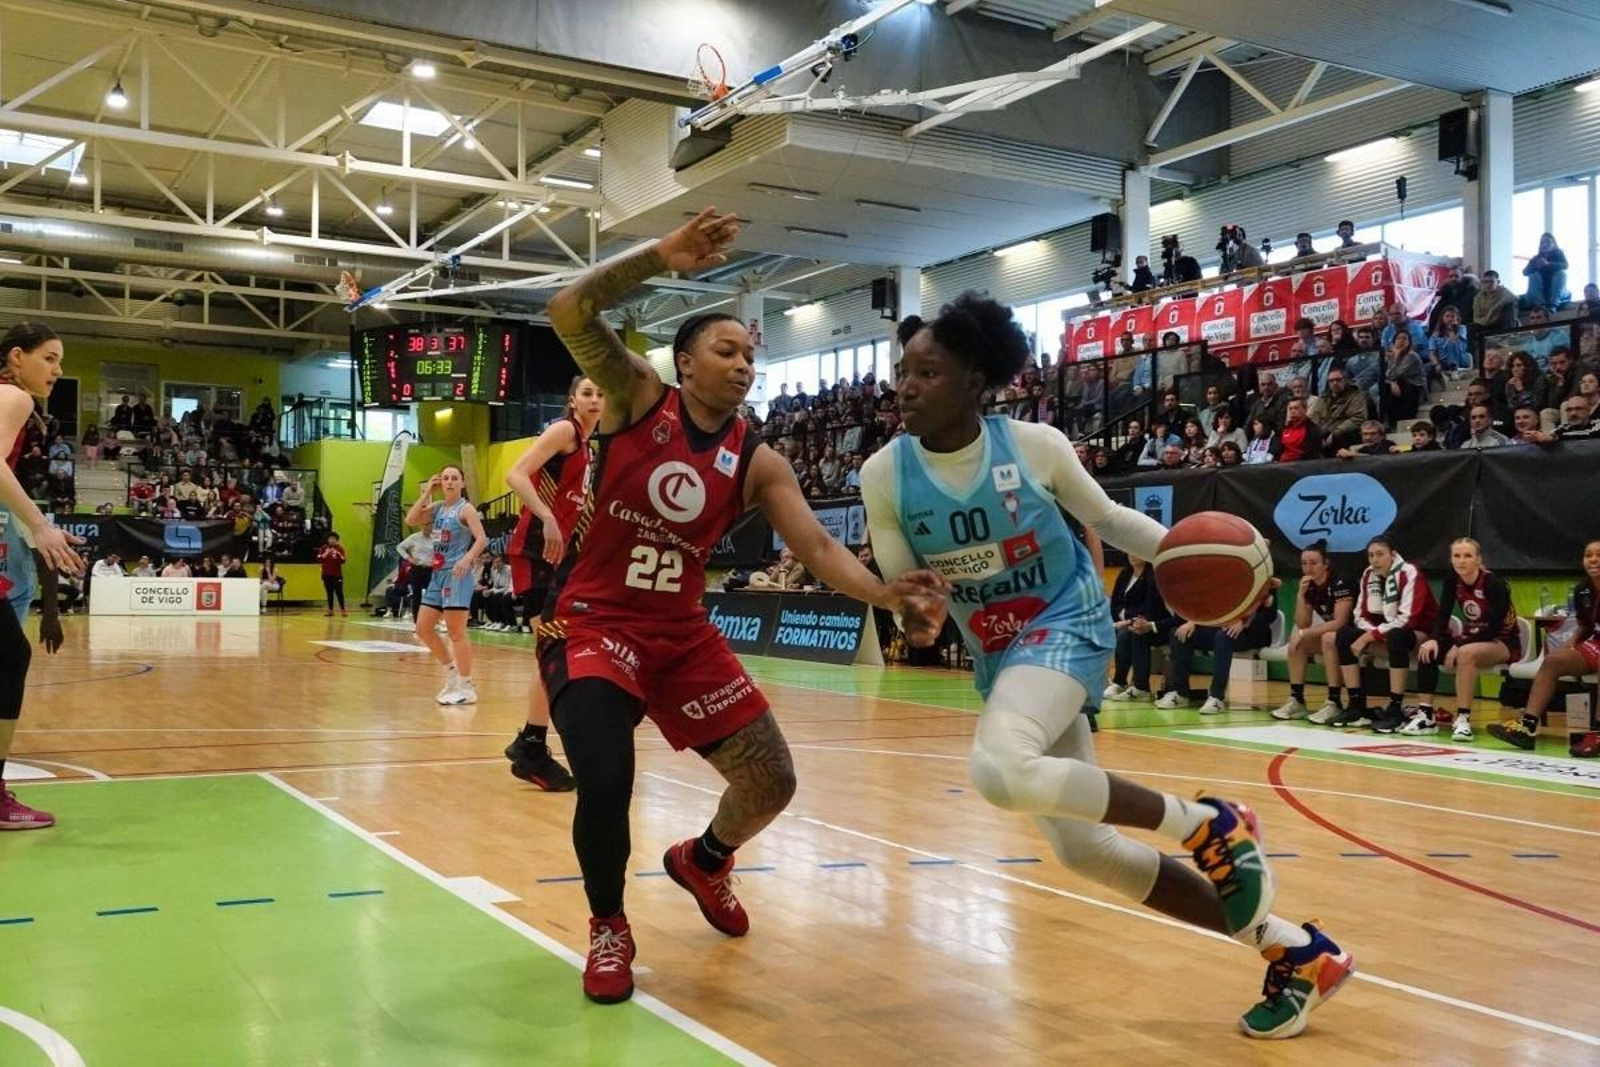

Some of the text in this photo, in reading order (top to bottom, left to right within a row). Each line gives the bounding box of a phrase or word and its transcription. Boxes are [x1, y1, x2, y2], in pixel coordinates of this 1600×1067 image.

[1302, 301, 1337, 315] Concello
[1251, 310, 1285, 323] Concello
[1316, 313, 1334, 324] Vigo
[1203, 319, 1234, 332] Concello
[1253, 322, 1281, 334] de Vigo
[408, 336, 465, 351] 38 3 37
[416, 360, 452, 375] 06:33
[456, 384, 465, 395] 2
[1298, 492, 1371, 535] Zorka
[949, 506, 991, 546] 00
[929, 550, 994, 568] CONCELLO
[624, 544, 684, 593] 22
[941, 560, 989, 576] DE VIGO
[950, 556, 1048, 604] Recalvi
[135, 587, 189, 596] CONCELLO
[141, 596, 182, 604] DE VIGO
[781, 610, 861, 629] Uniendo caminos
[981, 612, 1029, 645] Zork
[774, 627, 858, 650] FORMATIVOS
[701, 675, 746, 704] Zaragoza
[706, 685, 753, 715] DEPORTE
